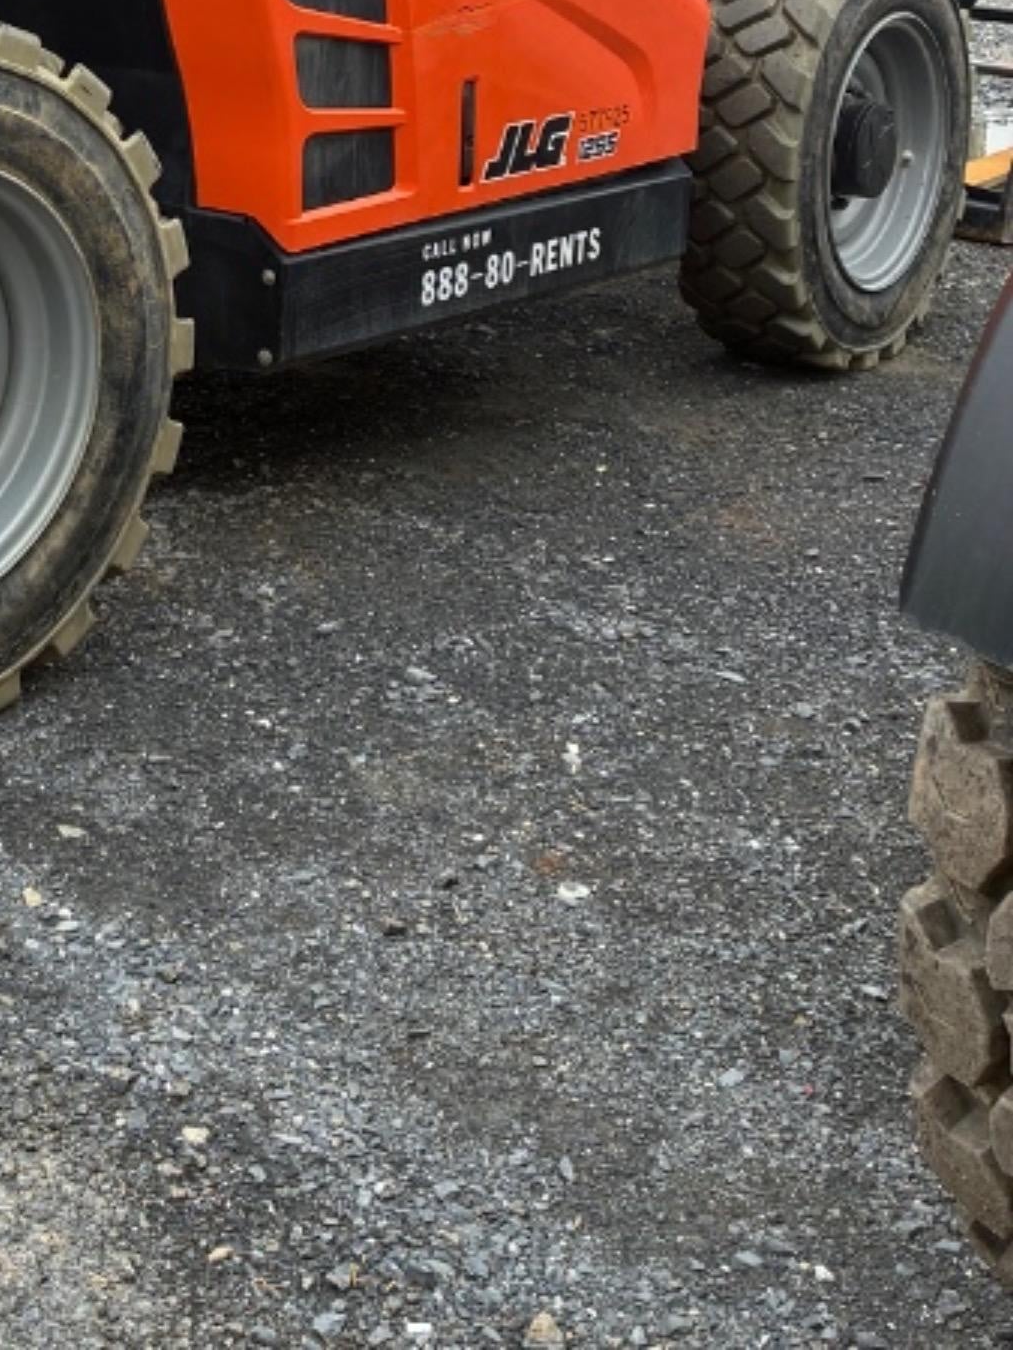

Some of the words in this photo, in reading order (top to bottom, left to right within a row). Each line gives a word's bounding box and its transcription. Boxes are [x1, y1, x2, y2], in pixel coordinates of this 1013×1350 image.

[482, 111, 575, 182] JLG
[421, 227, 601, 306] 888-80-RENTS
[422, 239, 456, 261] CALL
[463, 228, 492, 251] NOW
